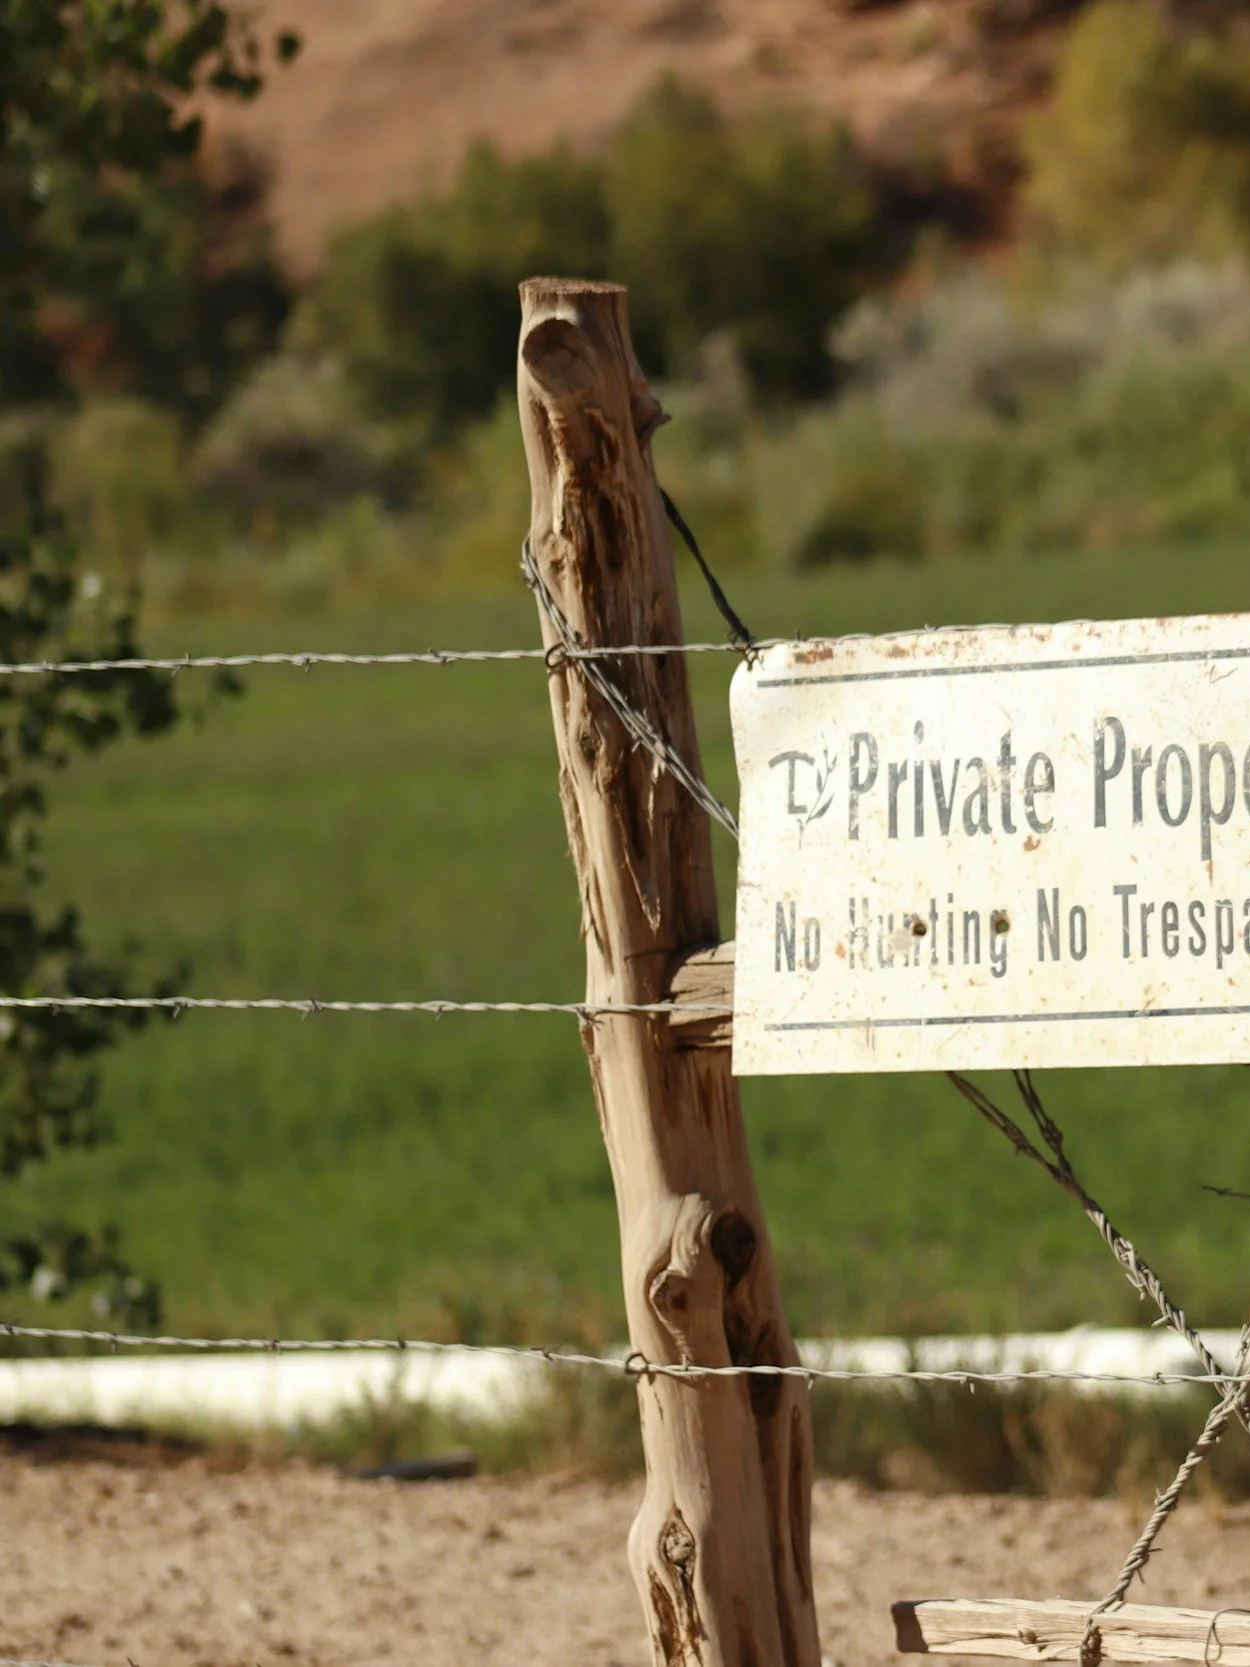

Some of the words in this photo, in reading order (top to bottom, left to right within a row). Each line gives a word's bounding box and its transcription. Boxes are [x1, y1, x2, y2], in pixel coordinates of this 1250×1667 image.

[848, 719, 1055, 840] Private
[774, 900, 821, 972] No
[1036, 887, 1088, 962] No
